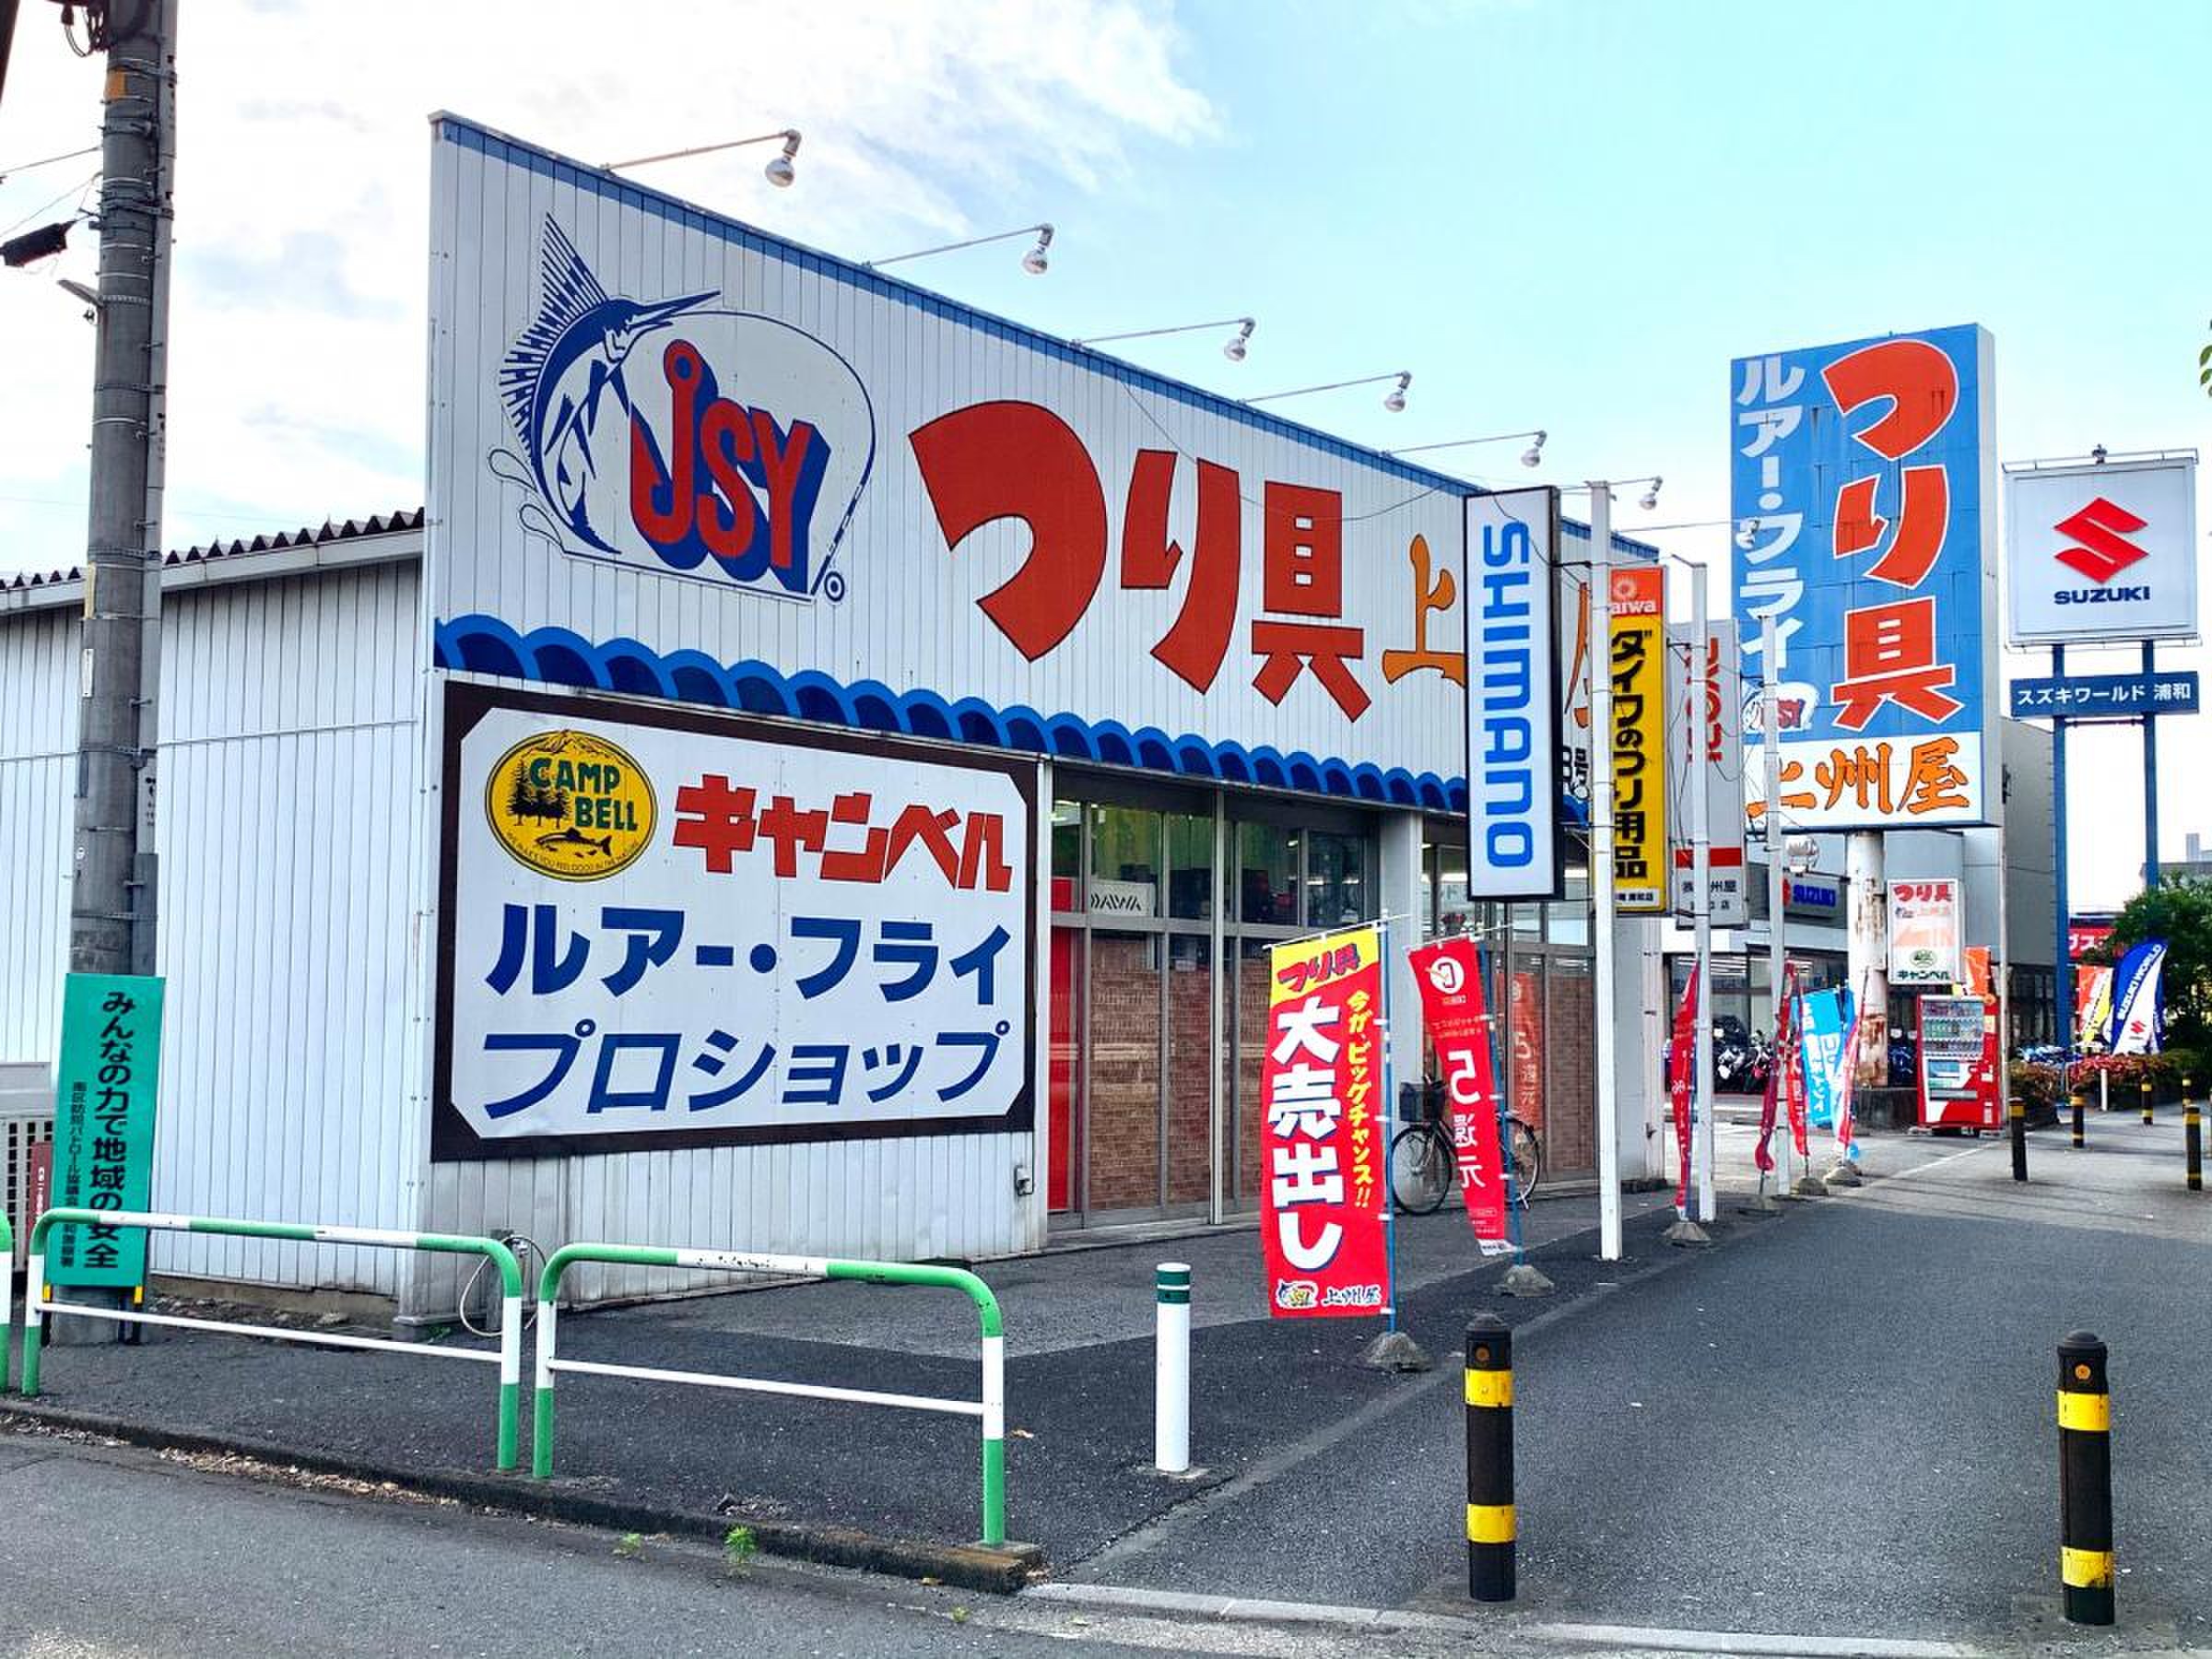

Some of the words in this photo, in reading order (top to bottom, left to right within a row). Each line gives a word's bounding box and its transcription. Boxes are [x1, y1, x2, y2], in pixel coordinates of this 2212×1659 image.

[909, 399, 1371, 723] つり具
[1821, 338, 1965, 732] つり具
[2053, 586, 2150, 605] SUZUKI
[1482, 522, 1535, 868] SHIMANO
[2018, 685, 2146, 705] スズキワールド
[2153, 683, 2192, 700] 浦和
[530, 757, 620, 795] CAMP
[575, 795, 639, 831] BELL
[673, 774, 1013, 892] キャンベル
[1894, 884, 1953, 901] つり具
[484, 902, 1012, 1006] ルアー・フライ
[1277, 943, 1360, 993] つり具
[483, 1018, 1011, 1120] プロショップ
[1267, 995, 1346, 1270] 大売出し
